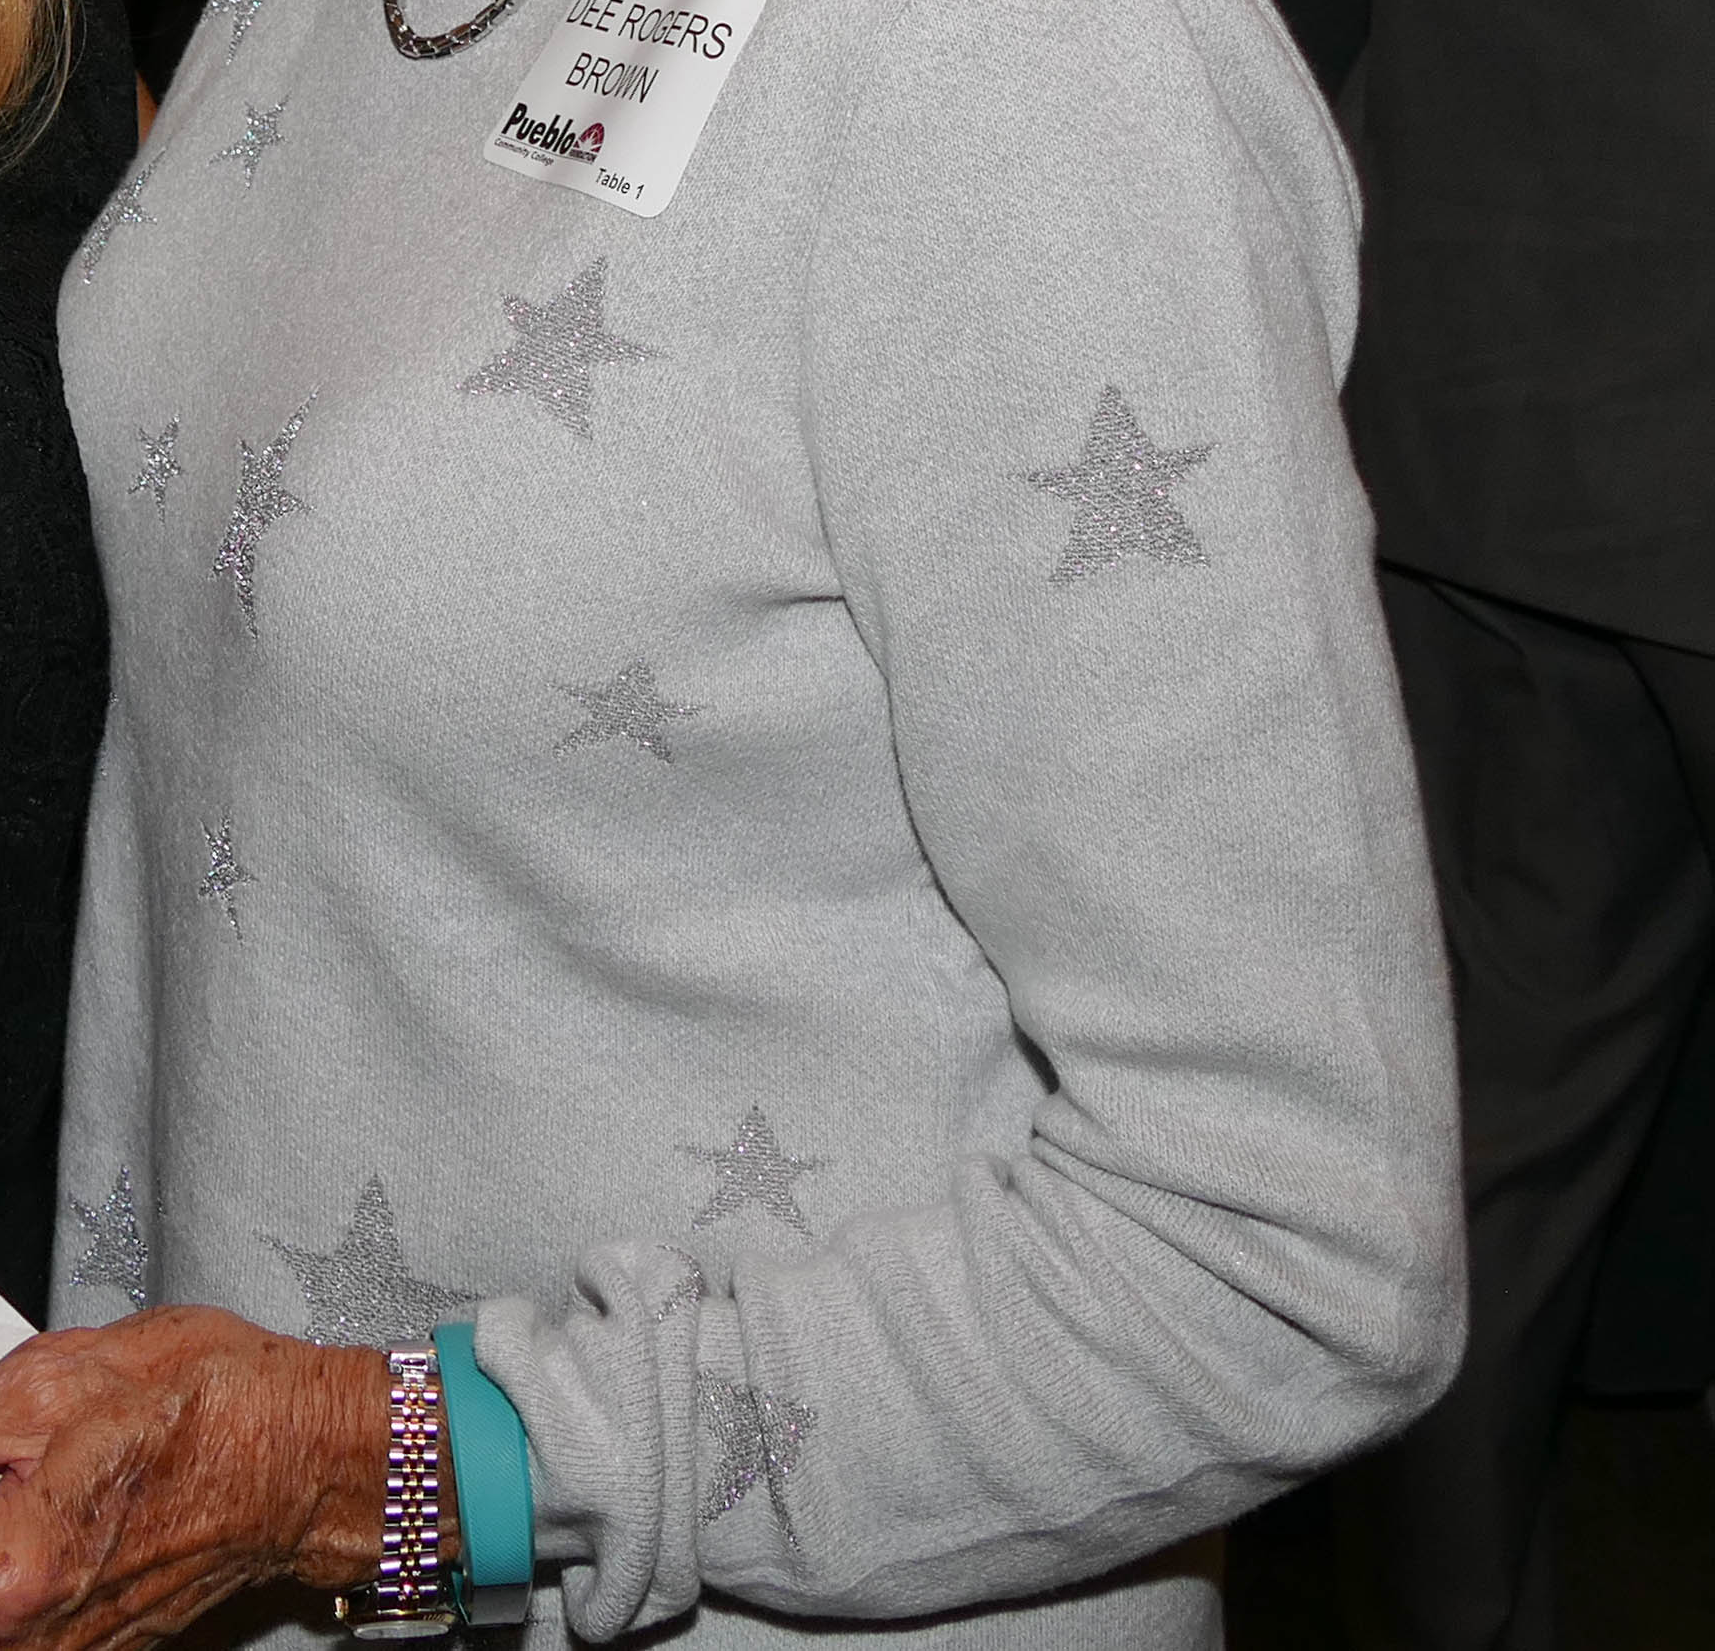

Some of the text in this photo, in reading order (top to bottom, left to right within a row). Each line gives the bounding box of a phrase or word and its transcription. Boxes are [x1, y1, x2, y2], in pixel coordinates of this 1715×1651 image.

[617, 3, 733, 60] ROGERS
[565, 52, 659, 103] BROWN
[493, 137, 555, 166] Community College
[501, 102, 576, 155] Pueblo
[595, 168, 645, 200] Table 1
